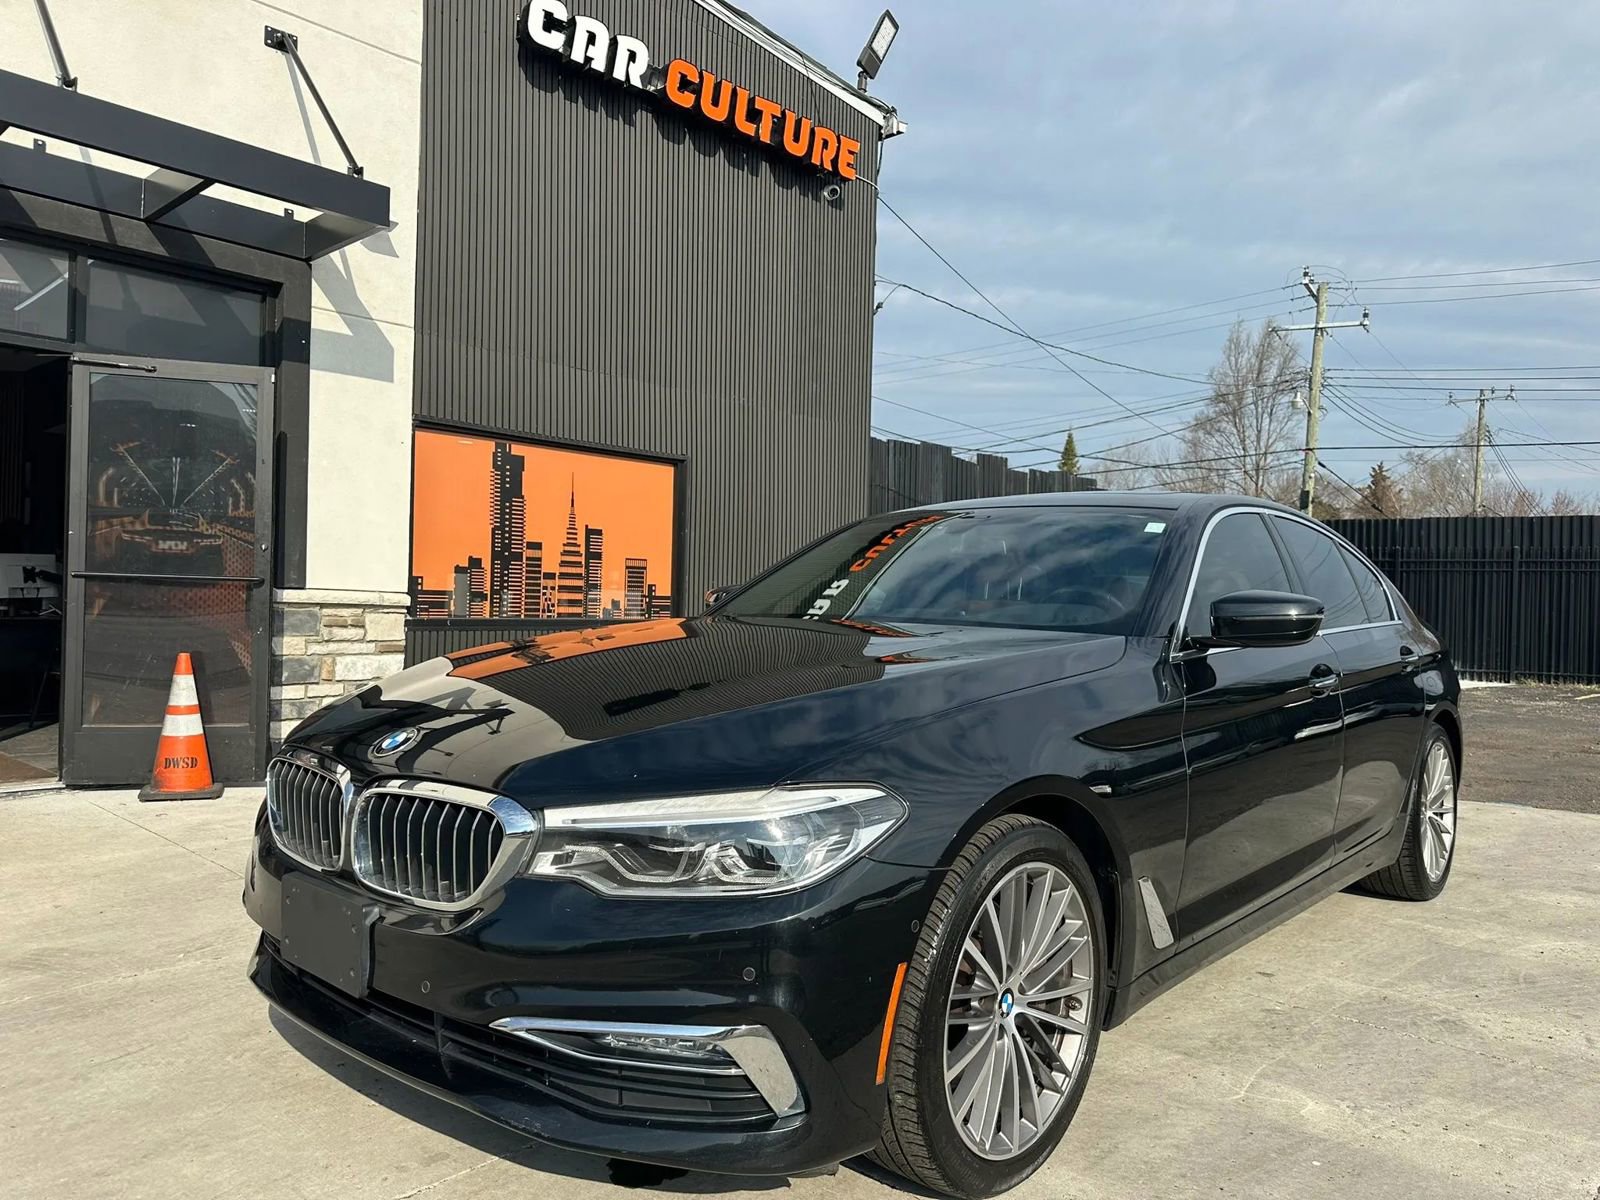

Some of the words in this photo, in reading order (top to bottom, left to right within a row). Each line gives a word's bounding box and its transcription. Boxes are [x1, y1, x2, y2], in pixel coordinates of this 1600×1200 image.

[526, 0, 650, 91] CAR
[665, 57, 861, 181] CULTURE
[163, 756, 199, 770] DWSD
